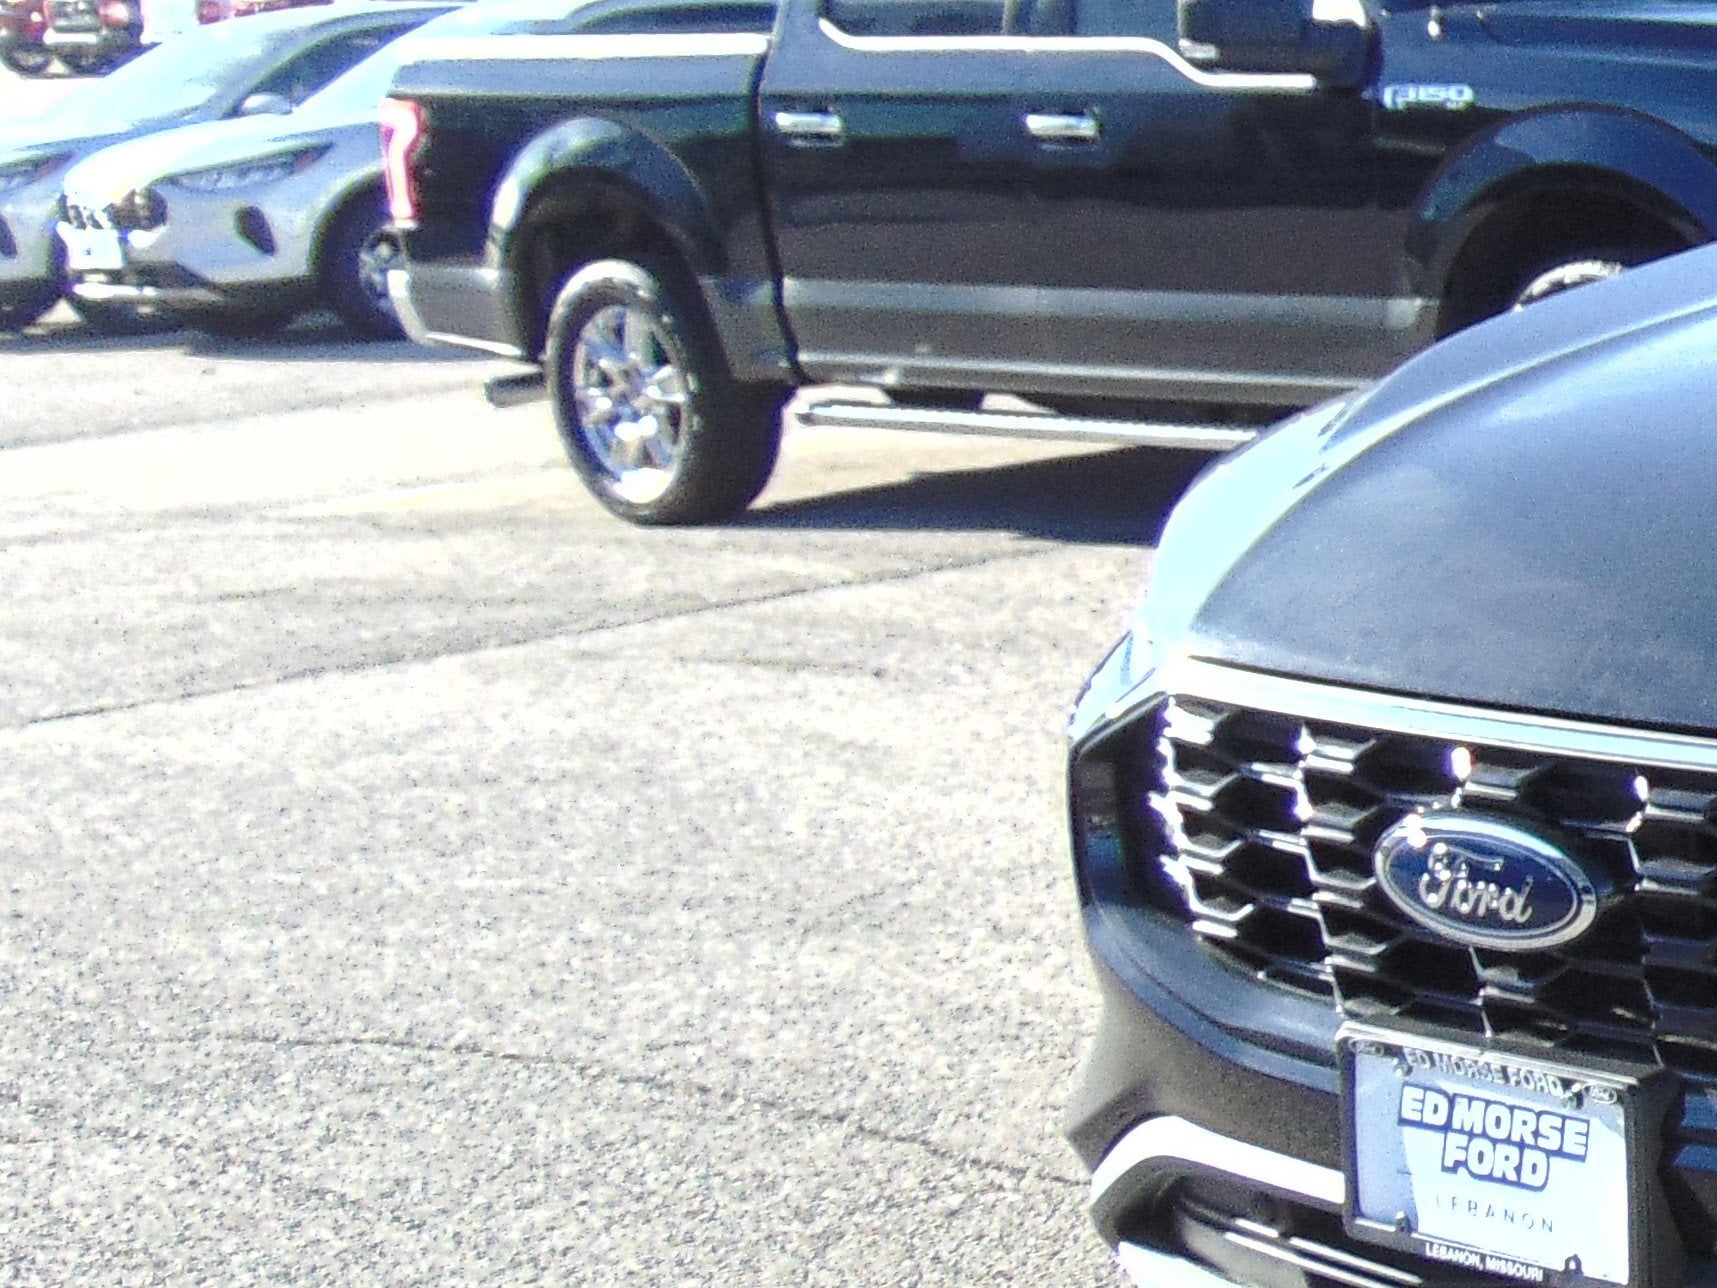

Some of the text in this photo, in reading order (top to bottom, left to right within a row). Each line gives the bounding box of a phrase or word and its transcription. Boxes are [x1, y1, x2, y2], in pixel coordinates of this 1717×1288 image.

[1419, 842, 1534, 924] Ford
[1433, 1053, 1506, 1085] MORSE
[1506, 1067, 1564, 1097] FORD
[1402, 1086, 1588, 1155] ED MORSE
[1443, 1136, 1548, 1189] FORD
[1484, 1255, 1544, 1282] MISSOURI
